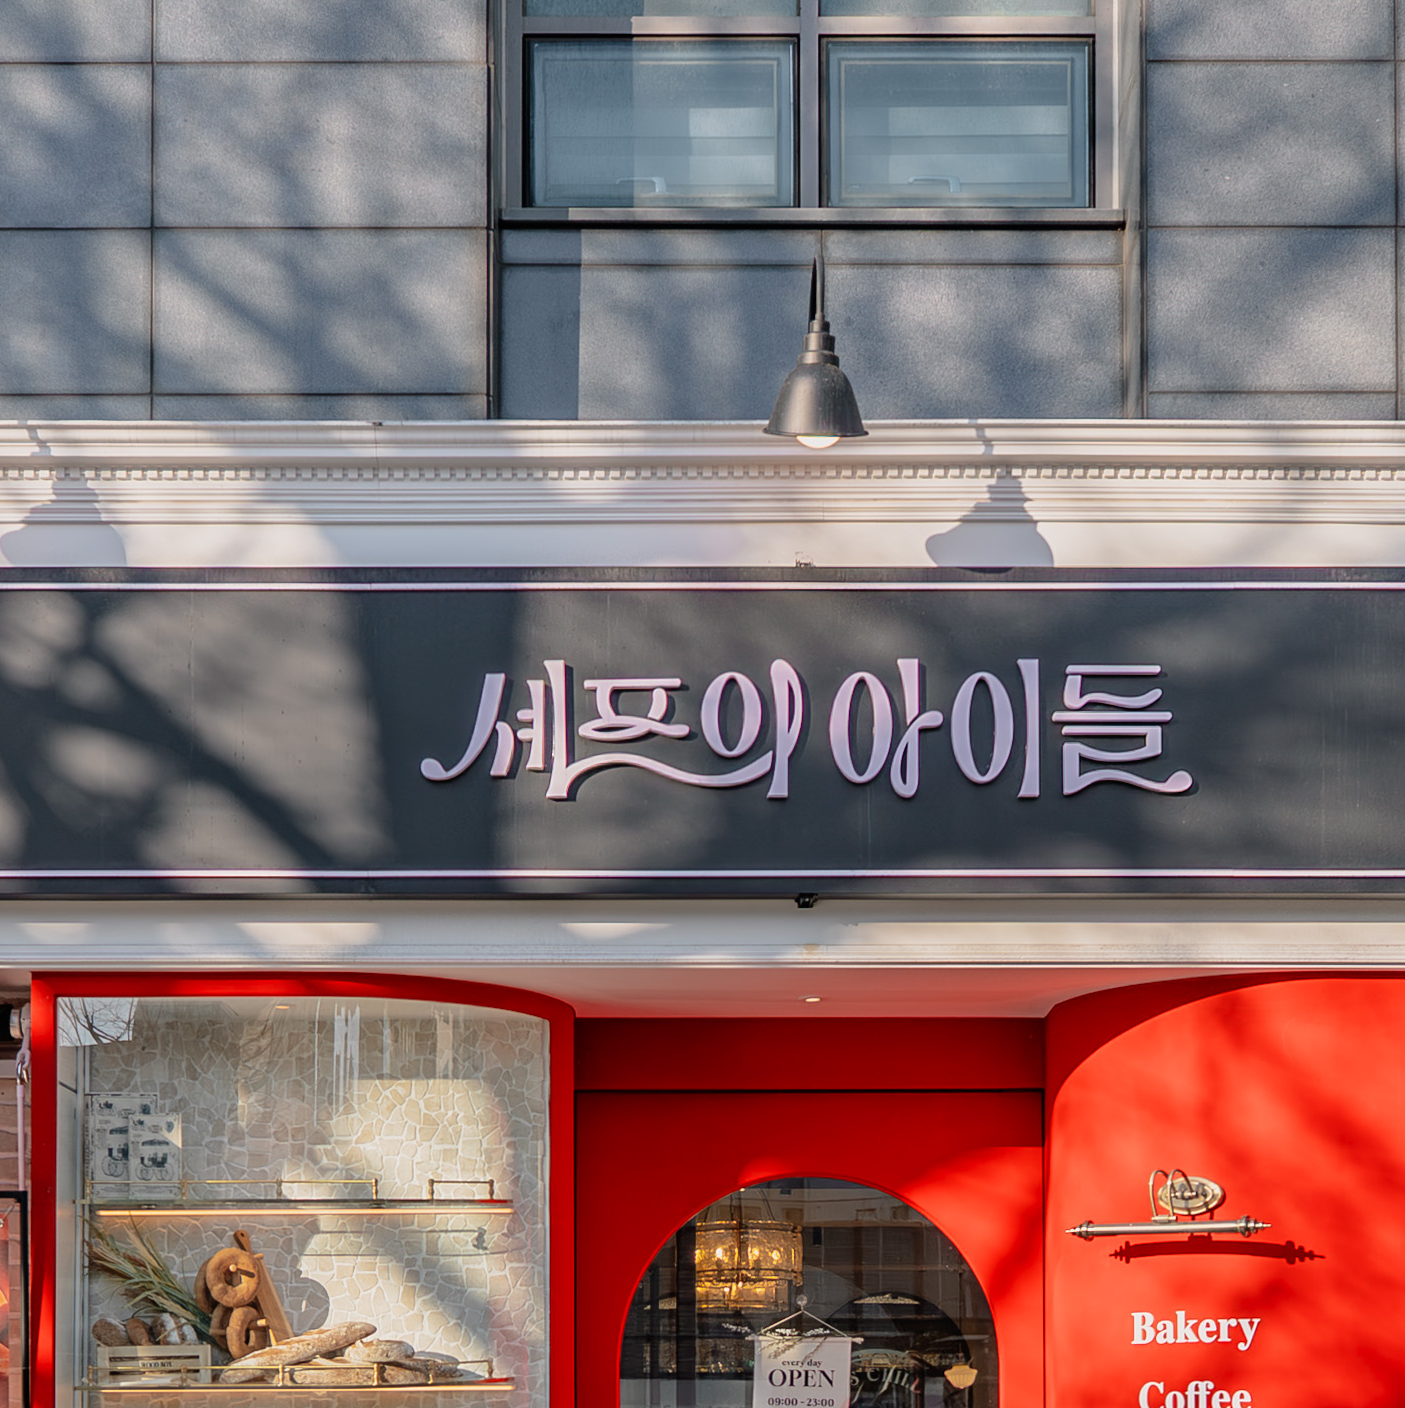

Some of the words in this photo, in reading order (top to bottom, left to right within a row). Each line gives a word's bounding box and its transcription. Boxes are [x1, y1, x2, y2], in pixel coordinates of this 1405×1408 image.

[420, 658, 800, 802] 셰프의
[830, 657, 1195, 800] 아이들
[1130, 1310, 1261, 1351] Bakery
[806, 1358, 823, 1368] day
[768, 1368, 836, 1388] OPEN
[767, 1397, 798, 1406] 09:00
[806, 1398, 835, 1407] 23:00
